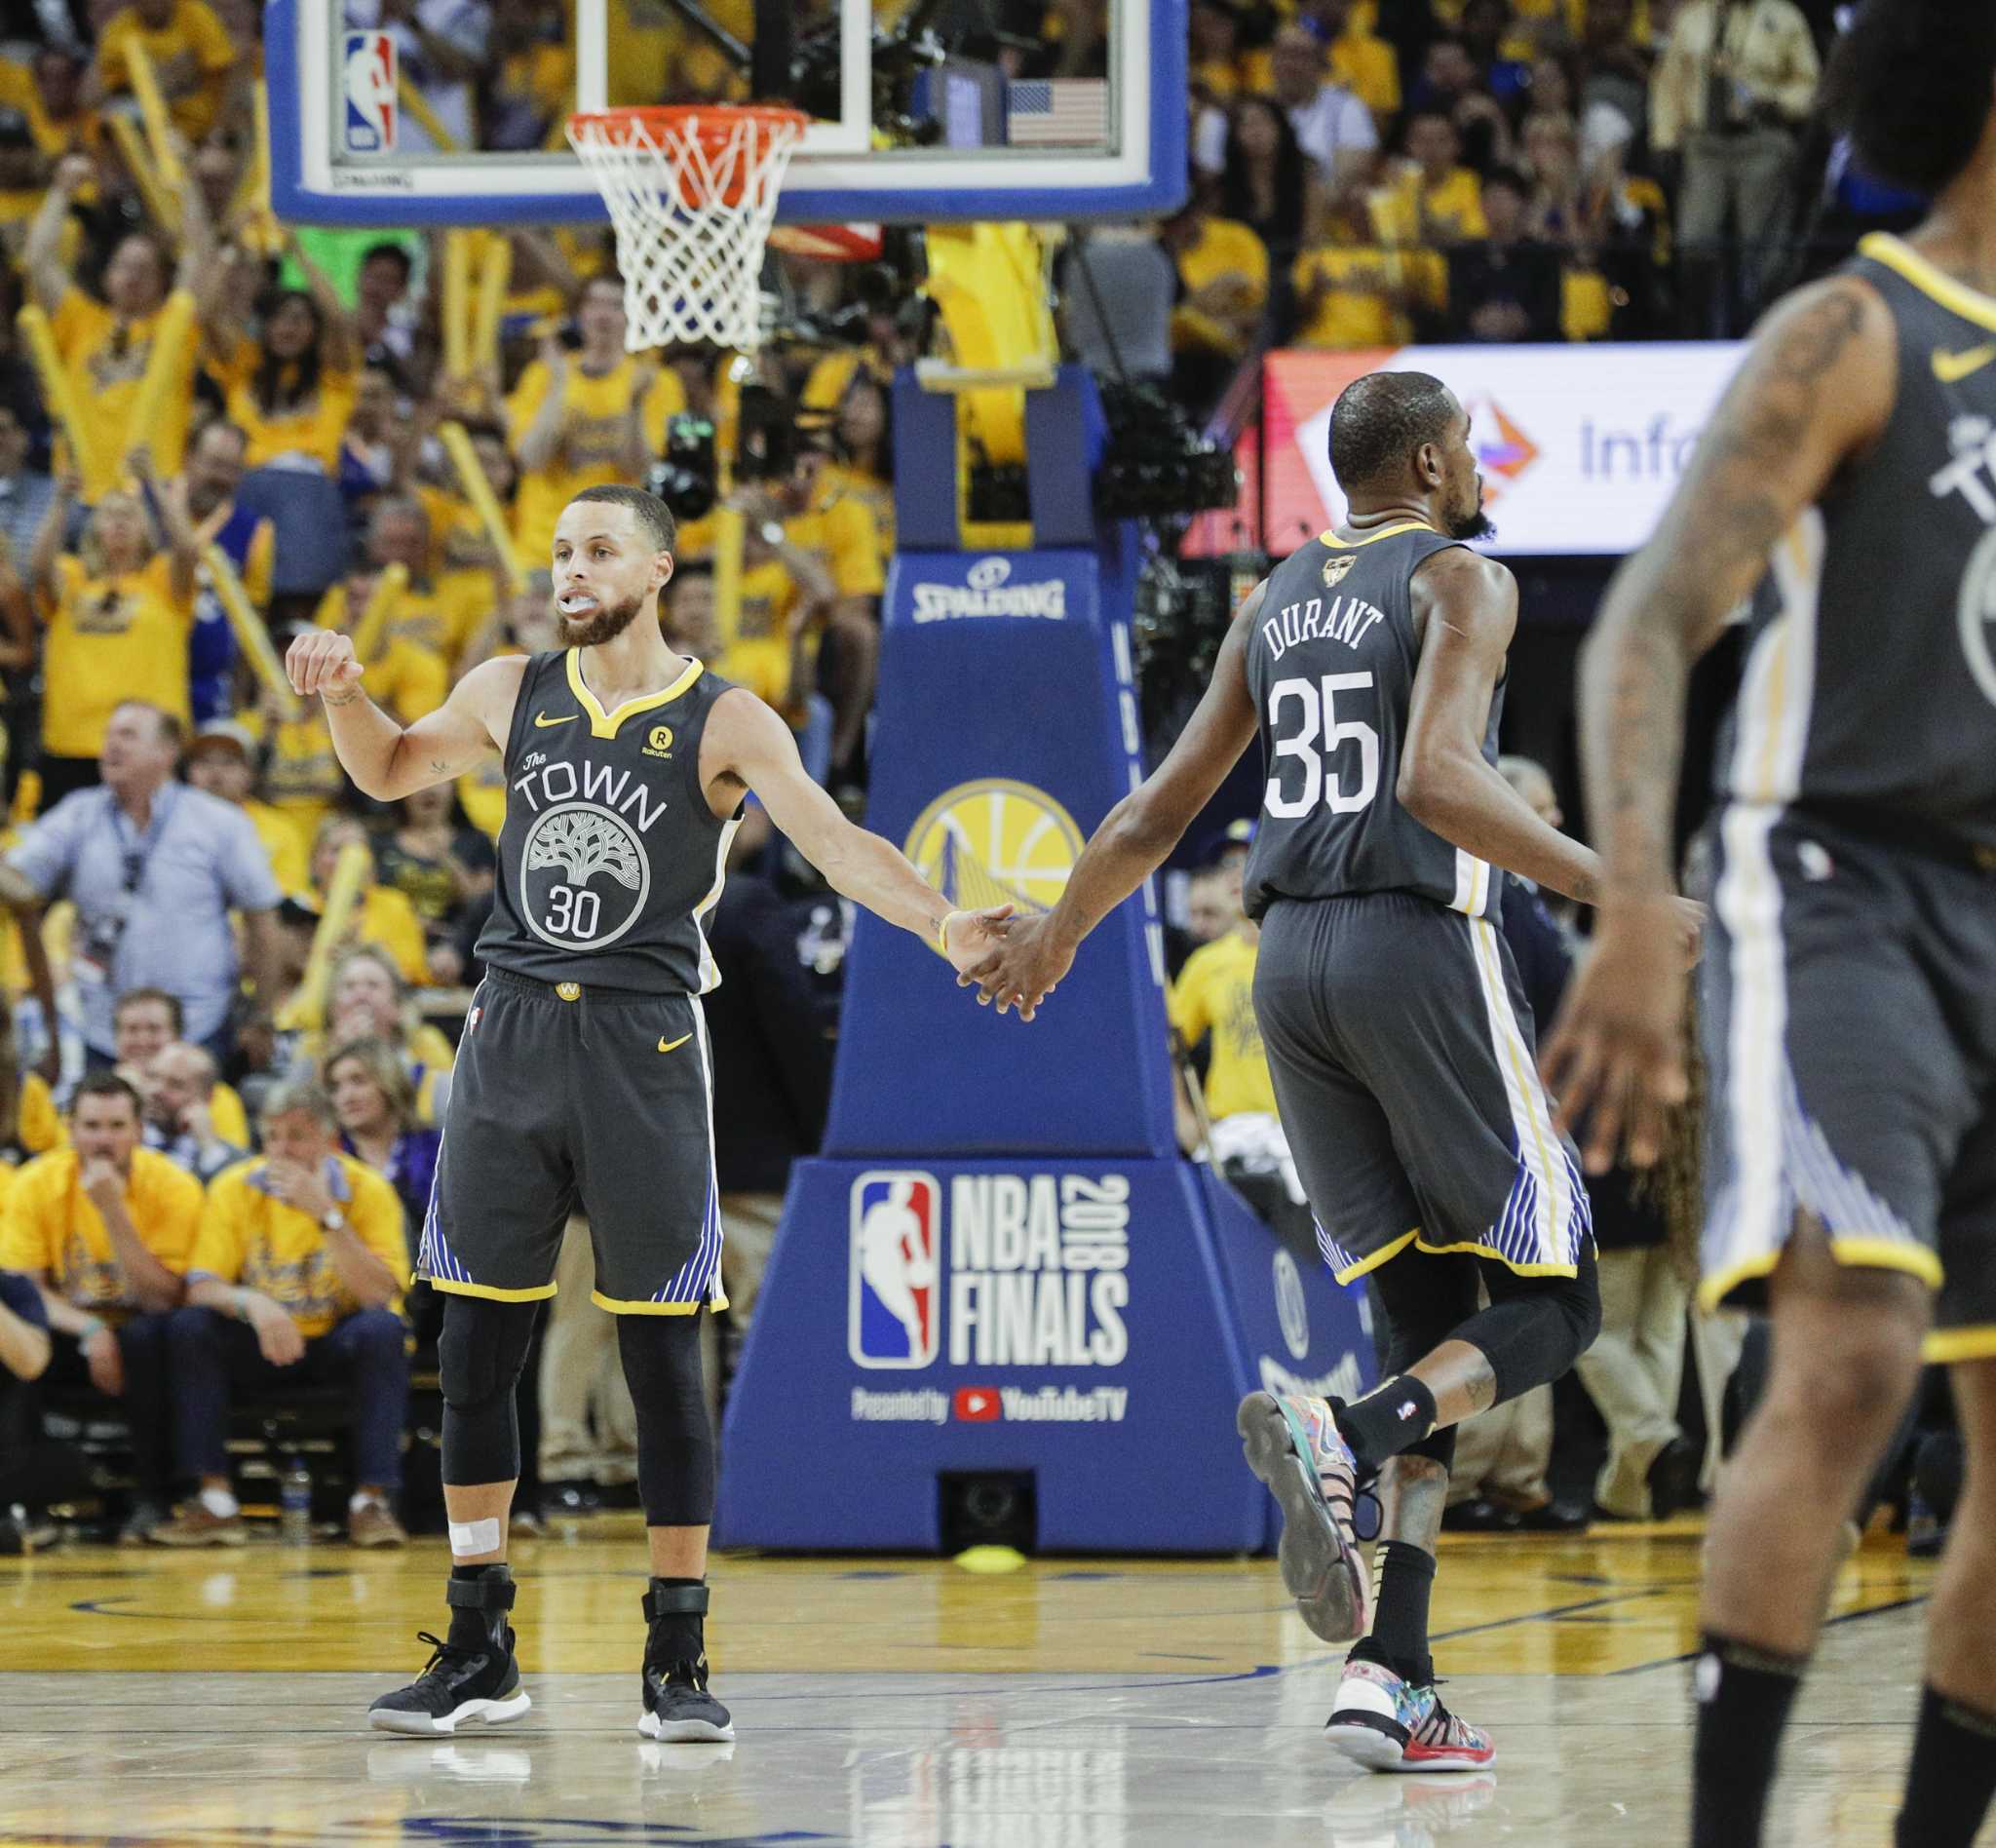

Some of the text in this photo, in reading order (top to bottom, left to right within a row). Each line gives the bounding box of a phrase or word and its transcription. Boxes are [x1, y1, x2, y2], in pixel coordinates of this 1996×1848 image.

[912, 579, 1066, 624] SPALDING
[1263, 597, 1384, 661] DURANT
[522, 751, 546, 771] The
[641, 747, 672, 760] Rakuten
[1264, 672, 1379, 818] 35
[515, 760, 668, 833] TOWN
[545, 885, 601, 939] 30
[950, 1174, 1062, 1271] NBA
[1060, 1174, 1131, 1271] 2018
[949, 1271, 1129, 1367] FINALS
